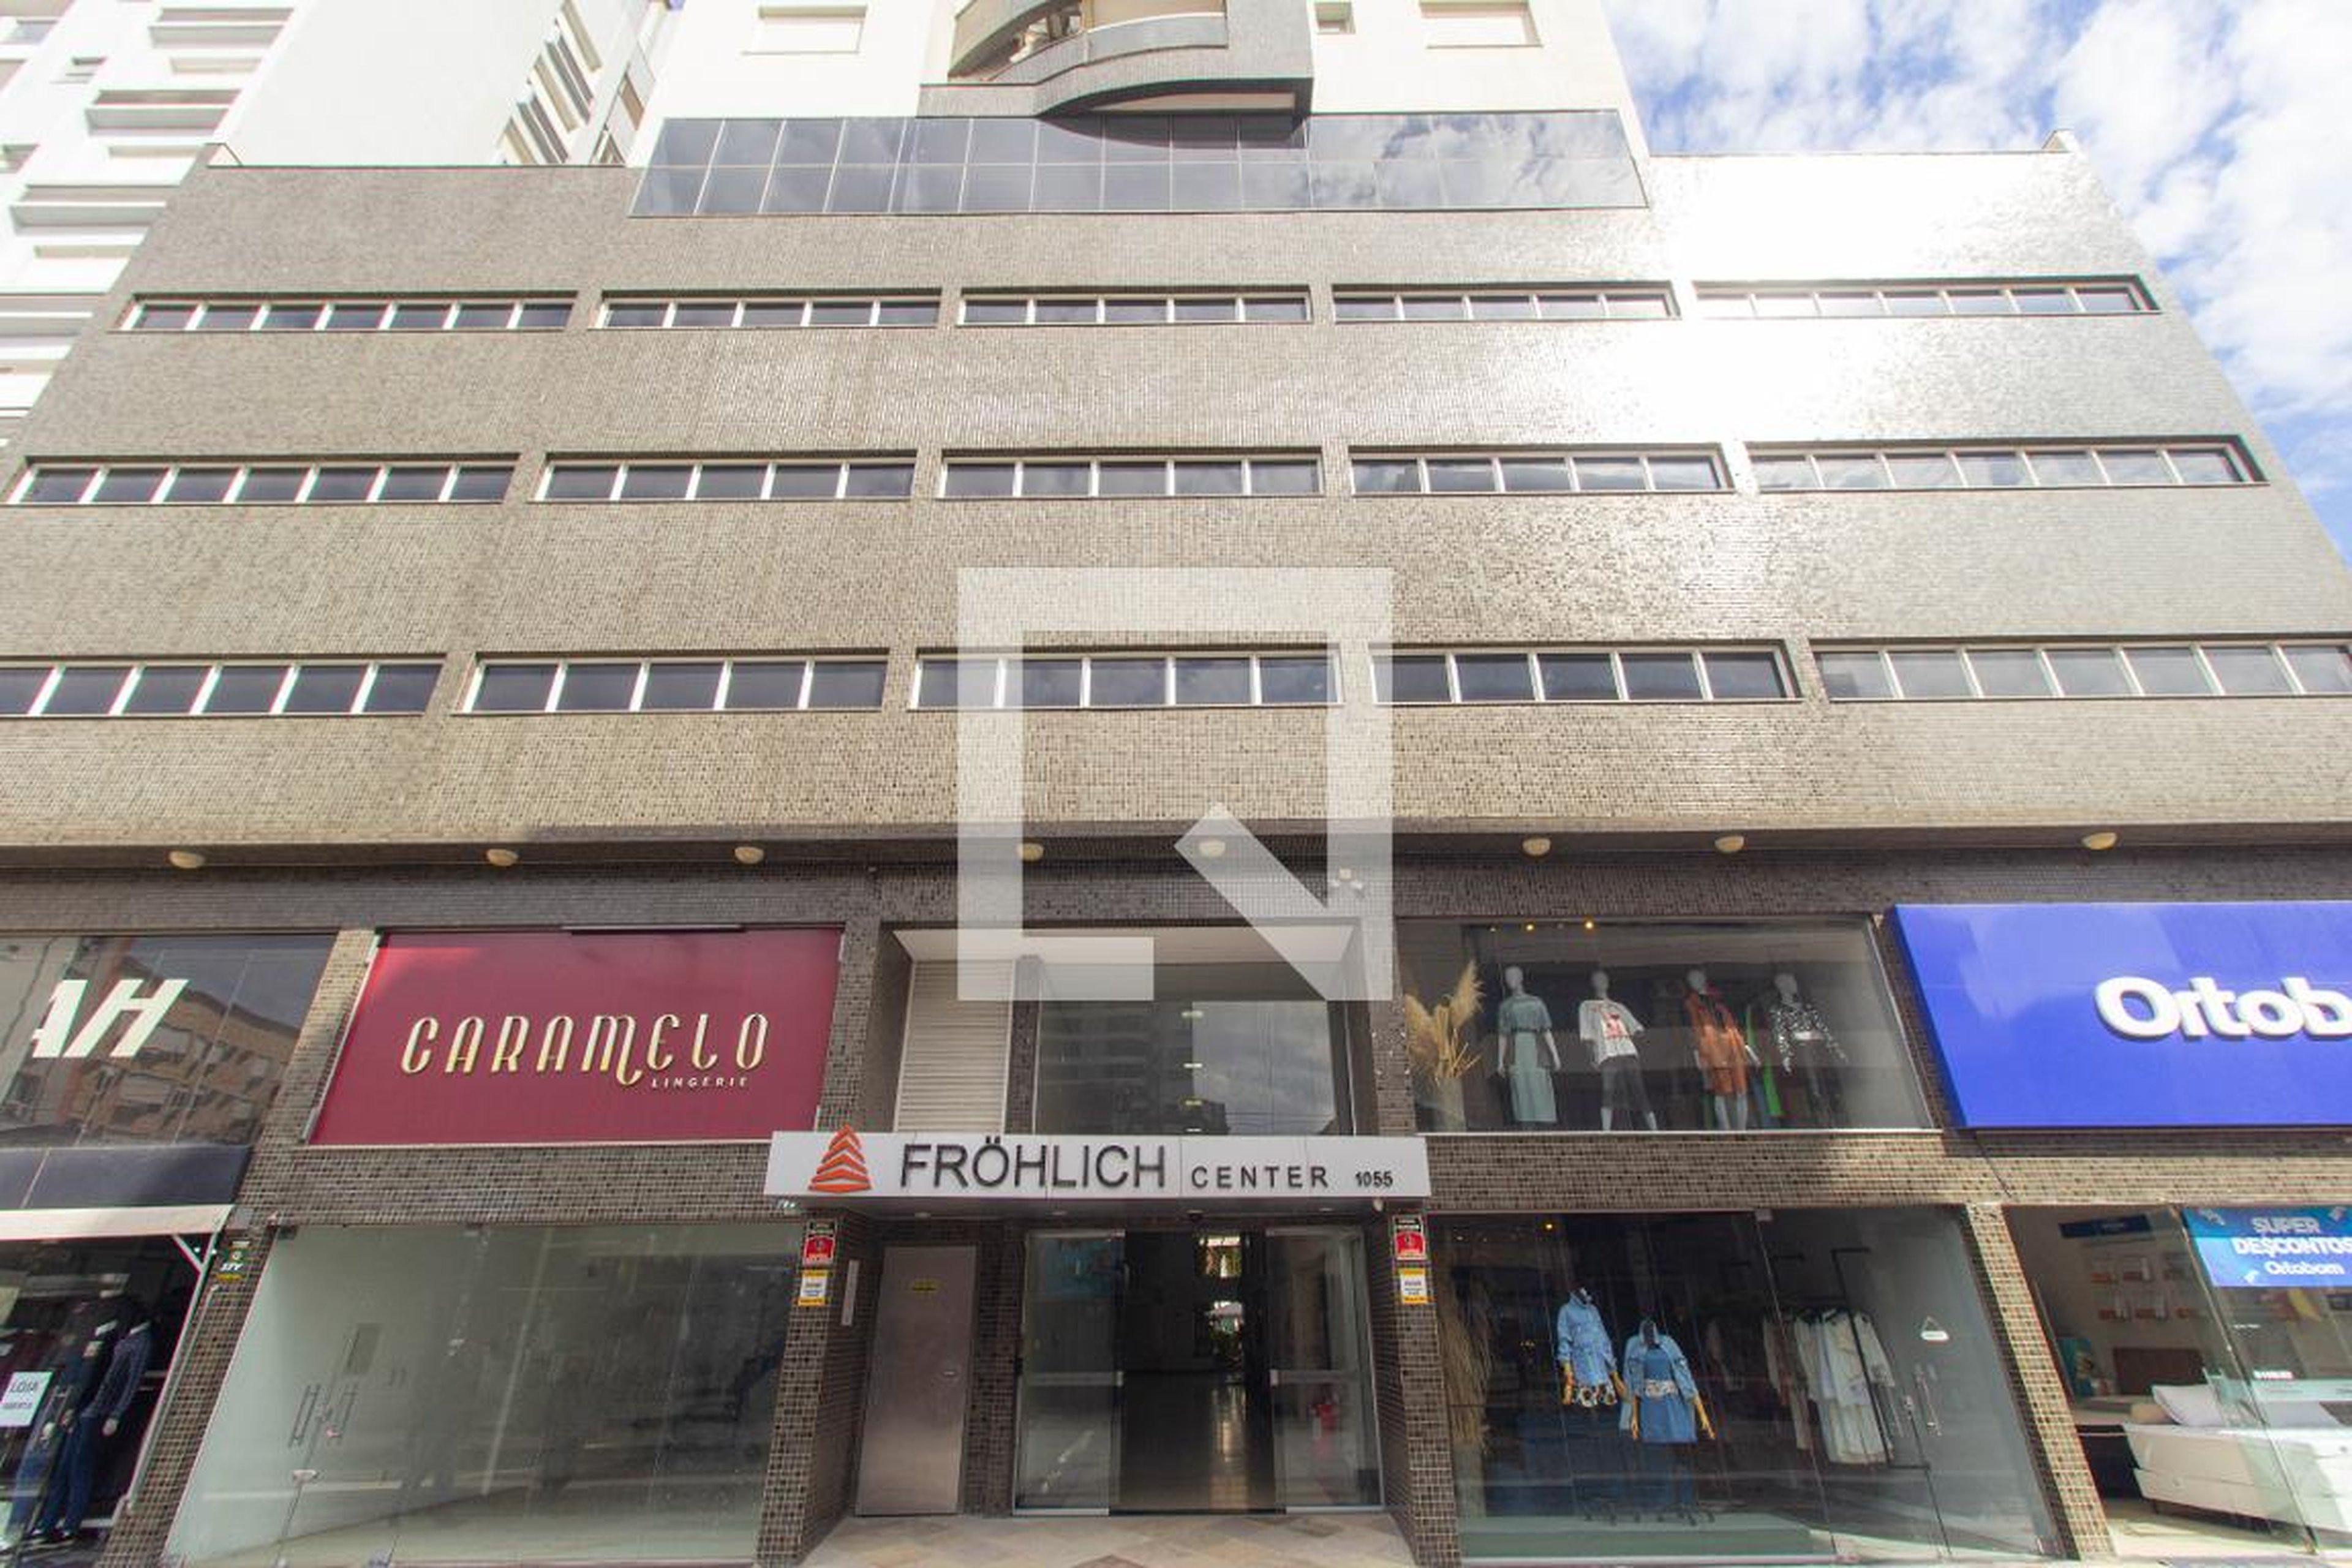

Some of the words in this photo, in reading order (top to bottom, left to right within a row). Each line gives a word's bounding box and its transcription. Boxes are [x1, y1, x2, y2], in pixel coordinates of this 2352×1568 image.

[401, 1012, 769, 1085] CARAMELO
[651, 1076, 749, 1088] LINGERIE
[900, 1136, 1165, 1188] FRÖHLICH
[1191, 1166, 1329, 1188] CENTER
[1355, 1170, 1393, 1188] 1055
[2251, 1216, 2320, 1234] SUPER
